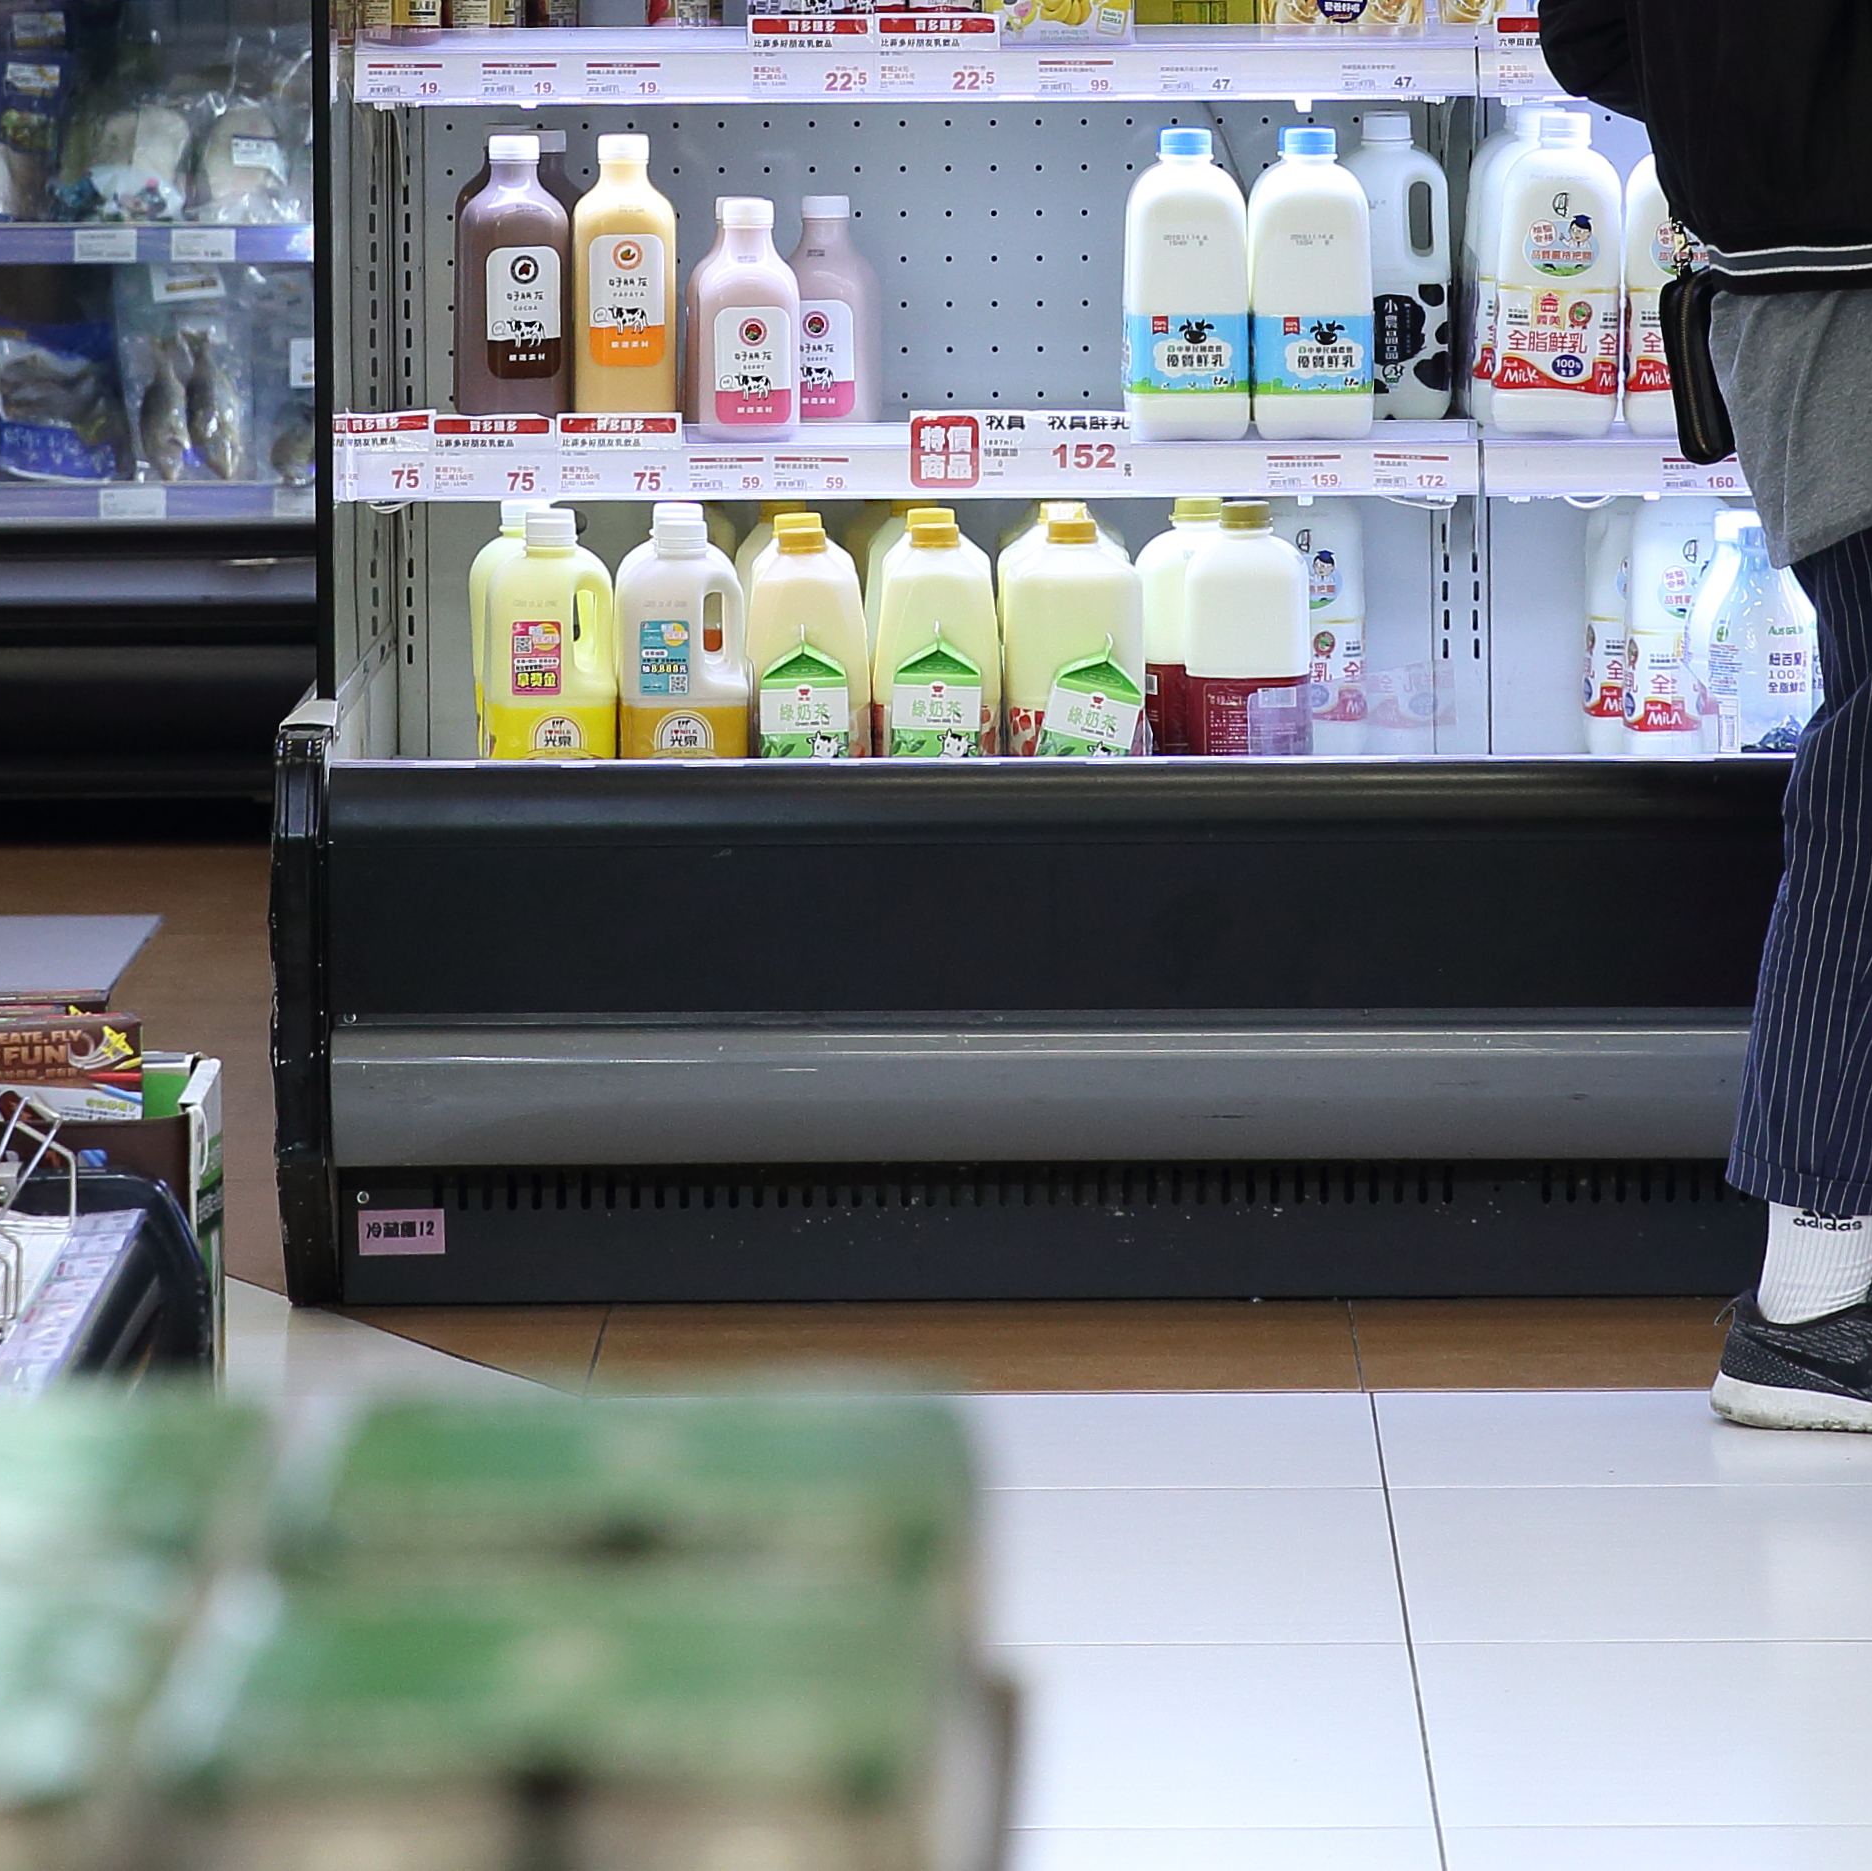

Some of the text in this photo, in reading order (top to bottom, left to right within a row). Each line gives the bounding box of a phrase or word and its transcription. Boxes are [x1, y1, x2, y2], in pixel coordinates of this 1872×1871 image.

[419, 82, 437, 94] 19
[533, 82, 552, 94] 19
[638, 82, 656, 94] 19
[825, 71, 869, 92] 22.5
[952, 71, 995, 91] 22.5
[1090, 79, 1109, 91] 99
[1212, 78, 1230, 91] 47
[1394, 75, 1412, 89] 47
[1536, 314, 1561, 326] 義美
[1508, 330, 1588, 354] 全脂鮮乳
[1165, 354, 1225, 369] 優質鮮乳
[1296, 354, 1356, 369] 優質鮮乳
[1053, 443, 1117, 469] 152
[391, 469, 420, 489] 75
[507, 472, 535, 492] 75
[633, 472, 662, 491] 75
[741, 476, 760, 489] 59
[825, 476, 844, 489] 59
[1310, 474, 1339, 486] 159
[1416, 475, 1444, 487] 172
[1707, 476, 1734, 488] 160
[780, 702, 830, 720] 綠奶茶
[911, 700, 964, 718] 綠奶茶
[1068, 705, 1117, 731] 綠奶茶
[544, 735, 571, 747] 光泉
[669, 735, 698, 747] 光泉
[53, 1029, 83, 1044] FLY
[3, 1045, 68, 1067] FUN
